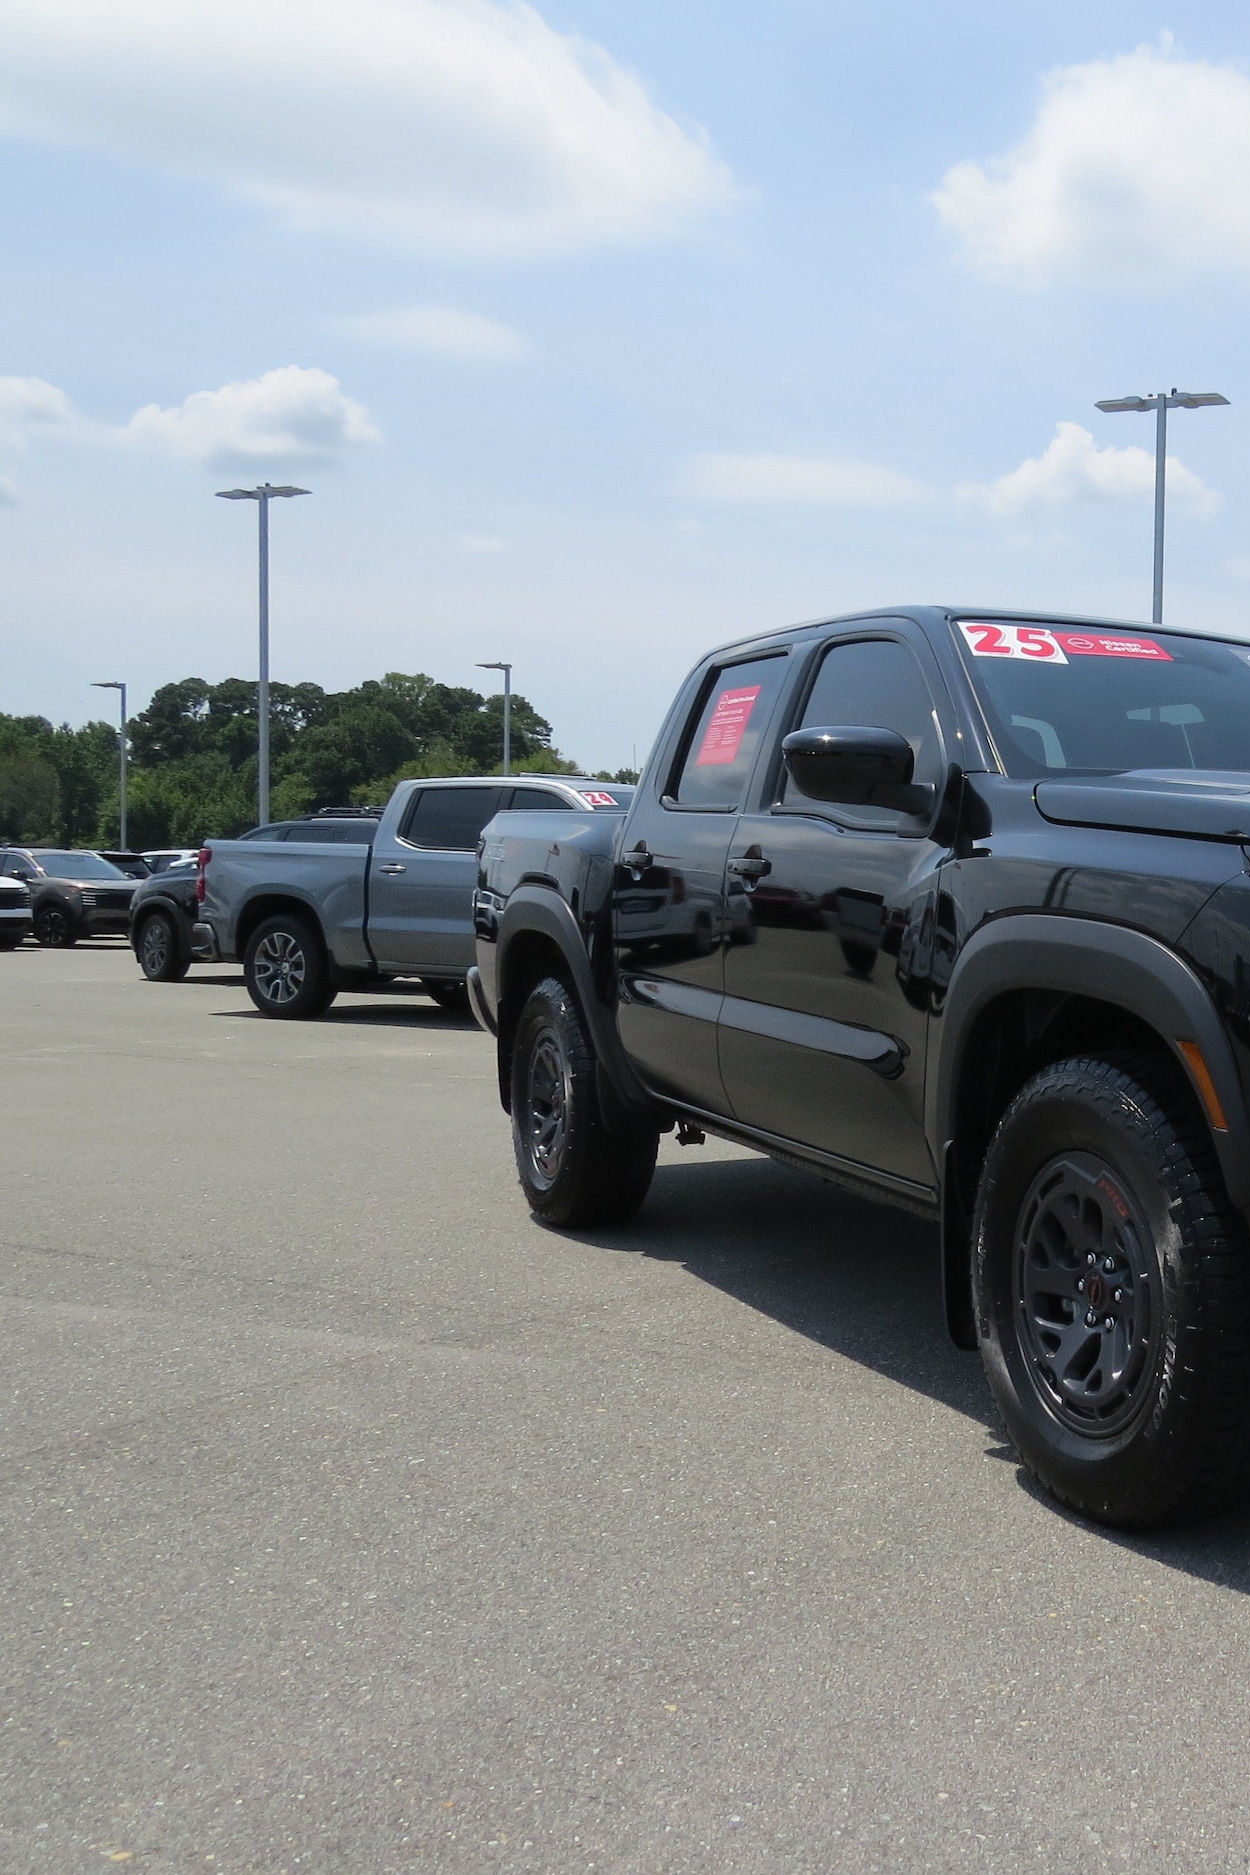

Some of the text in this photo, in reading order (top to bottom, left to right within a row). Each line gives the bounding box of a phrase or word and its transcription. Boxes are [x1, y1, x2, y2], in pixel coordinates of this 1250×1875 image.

[965, 625, 1057, 658] 25
[1098, 639, 1142, 648] Nissan
[1105, 645, 1159, 655] Certified
[584, 792, 615, 804] 24
